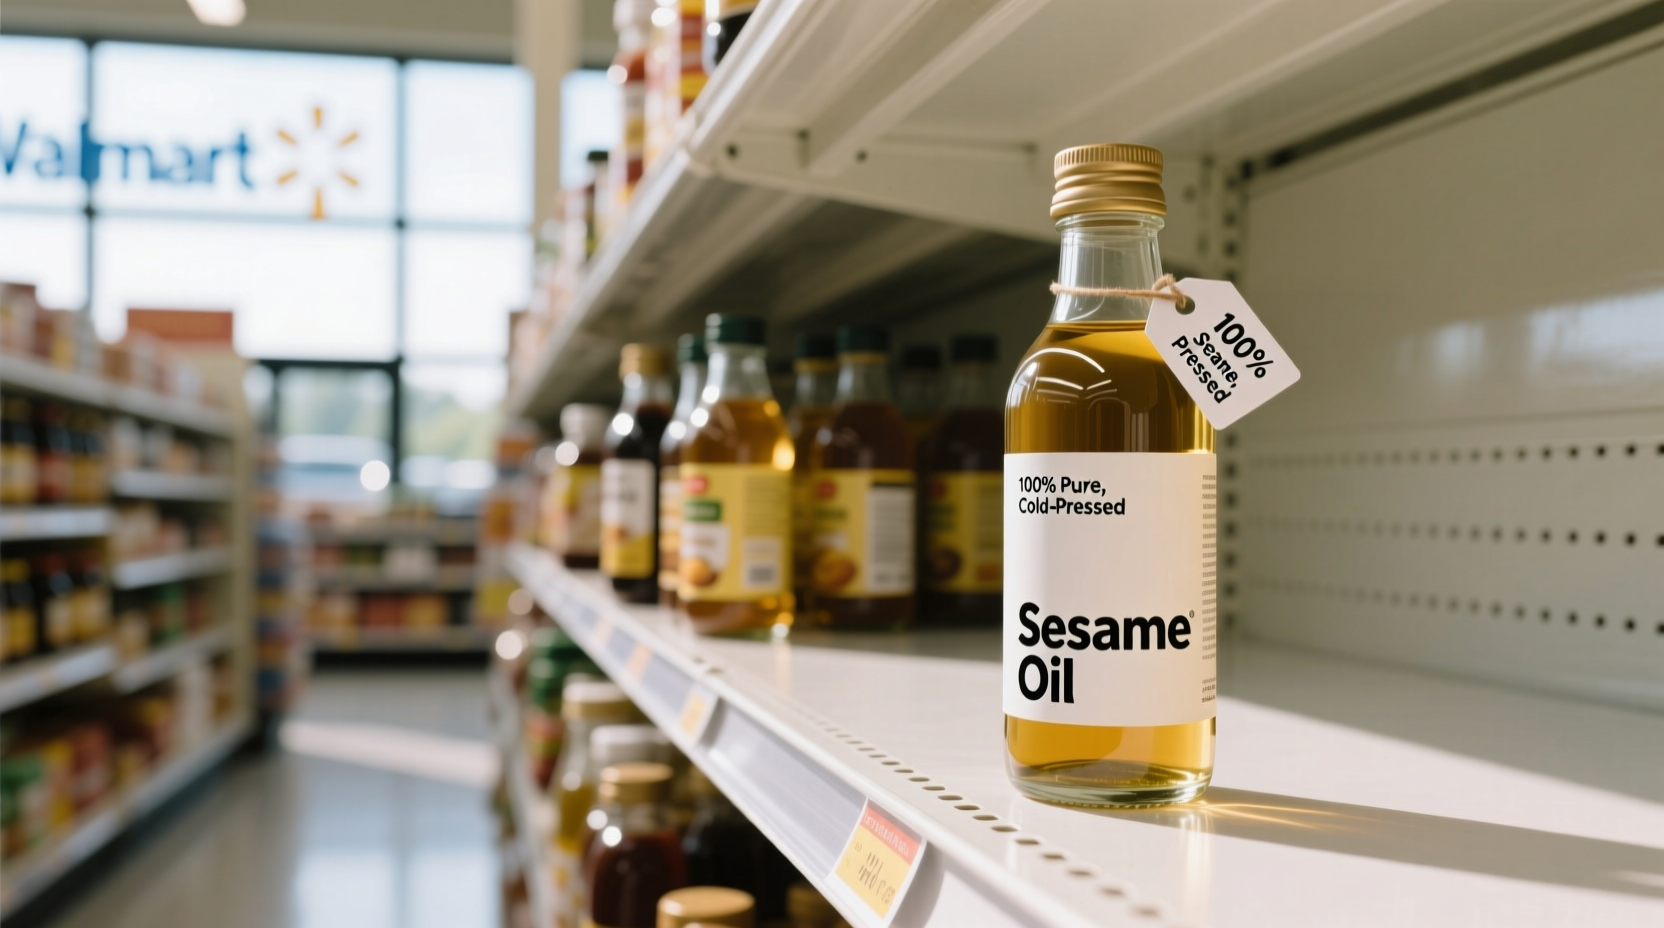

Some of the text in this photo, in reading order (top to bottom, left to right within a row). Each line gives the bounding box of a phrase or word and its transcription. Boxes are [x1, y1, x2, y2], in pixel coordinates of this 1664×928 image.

[1171, 335, 1232, 404] Pressed
[1213, 312, 1274, 379] 100%
[1018, 476, 1107, 497] 100% Pure,
[1018, 497, 1126, 516] Cold-Pressed
[1018, 654, 1075, 704] Oil
